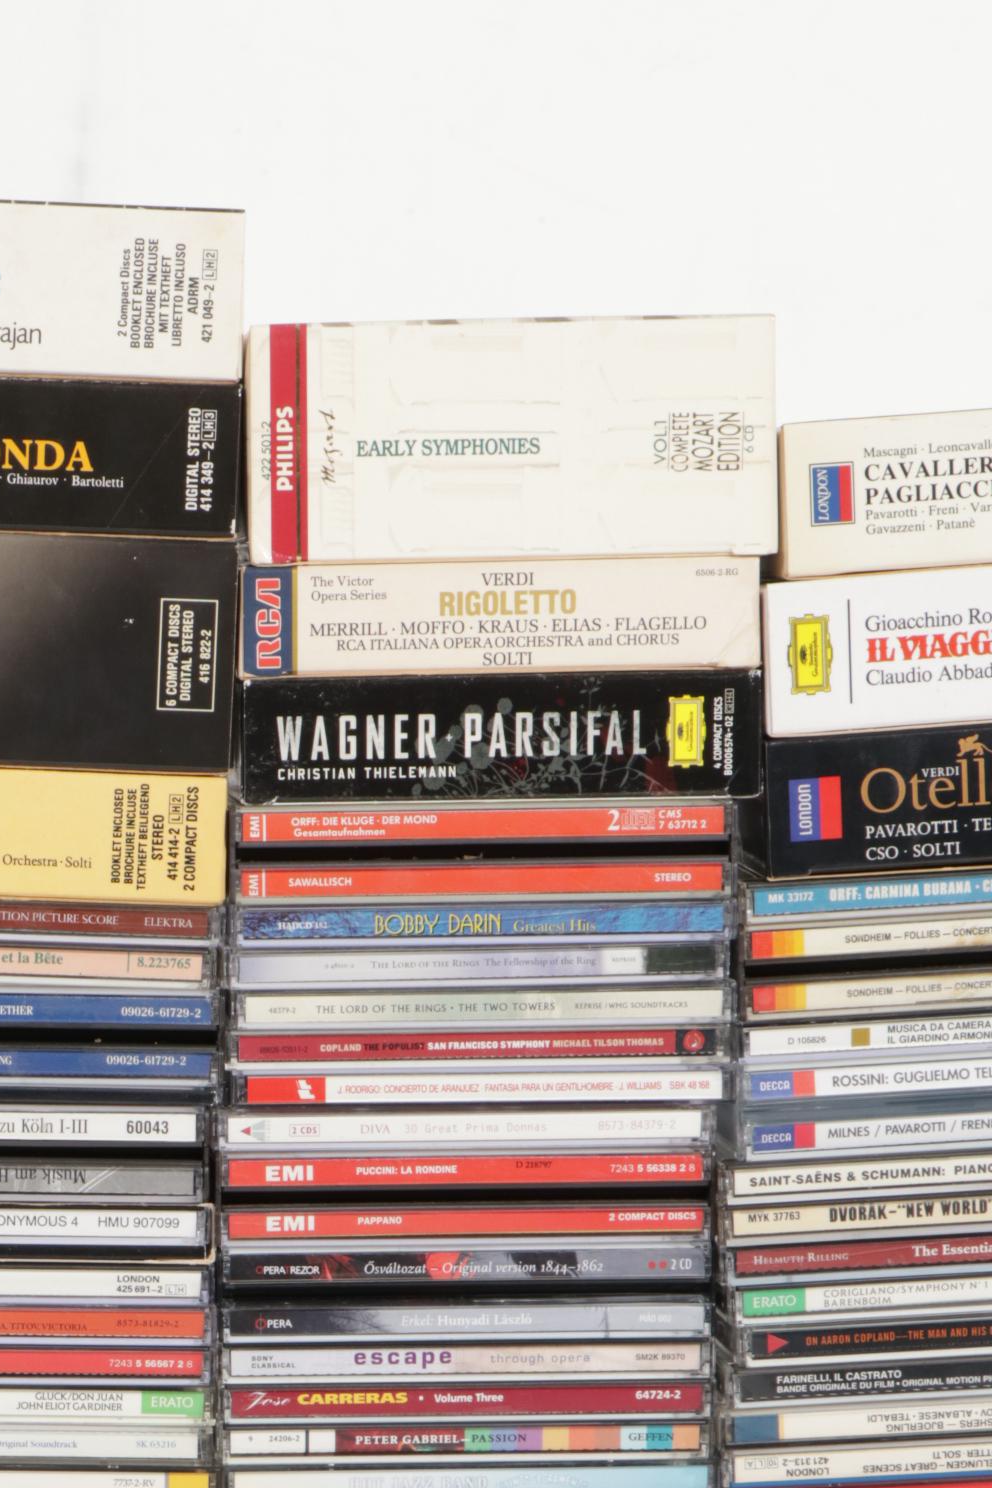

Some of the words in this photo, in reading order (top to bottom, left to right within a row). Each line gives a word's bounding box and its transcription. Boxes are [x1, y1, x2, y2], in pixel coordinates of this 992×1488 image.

[276, 407, 293, 490] PHILIPS
[357, 440, 416, 457] EARLY
[422, 438, 540, 456] SYMPHONIES
[7, 473, 58, 485] Ghiaurov
[72, 475, 123, 488] Bartoletti
[482, 572, 533, 586] VERDI
[440, 589, 576, 616] RIGOLETTO
[255, 578, 281, 669] RCA
[311, 623, 387, 636] MERRILL
[401, 621, 464, 635] MOFFO
[479, 619, 538, 633] KRAUS
[552, 618, 601, 632] ELIAS
[615, 616, 706, 631] FLAGELLO
[483, 652, 531, 665] SOLTI
[866, 667, 932, 686] Claudio
[277, 714, 437, 761] WAGNER
[464, 710, 646, 758] PARSIFAL
[278, 768, 355, 780] CHRISTIAN
[364, 766, 456, 778] THIELEMANN
[865, 820, 958, 839] PAVAROTTI
[866, 846, 899, 860] CSO
[913, 842, 960, 857] SOLTI
[913, 842, 960, 857] SOLTI
[3, 854, 57, 867] Orchestra
[65, 857, 91, 868] Solti
[289, 877, 352, 887] SAWALLISCH
[371, 912, 438, 934] BOBBY
[449, 913, 500, 933] DARIN
[0, 1122, 14, 1133] zu
[22, 1118, 53, 1133] Köln
[61, 1119, 87, 1133] I-III
[127, 1121, 168, 1134] 60043
[266, 1165, 313, 1181] EMI
[354, 1349, 453, 1369] escape
[151, 1396, 193, 1408] ERATO
[297, 1392, 408, 1405] CARRERAS
